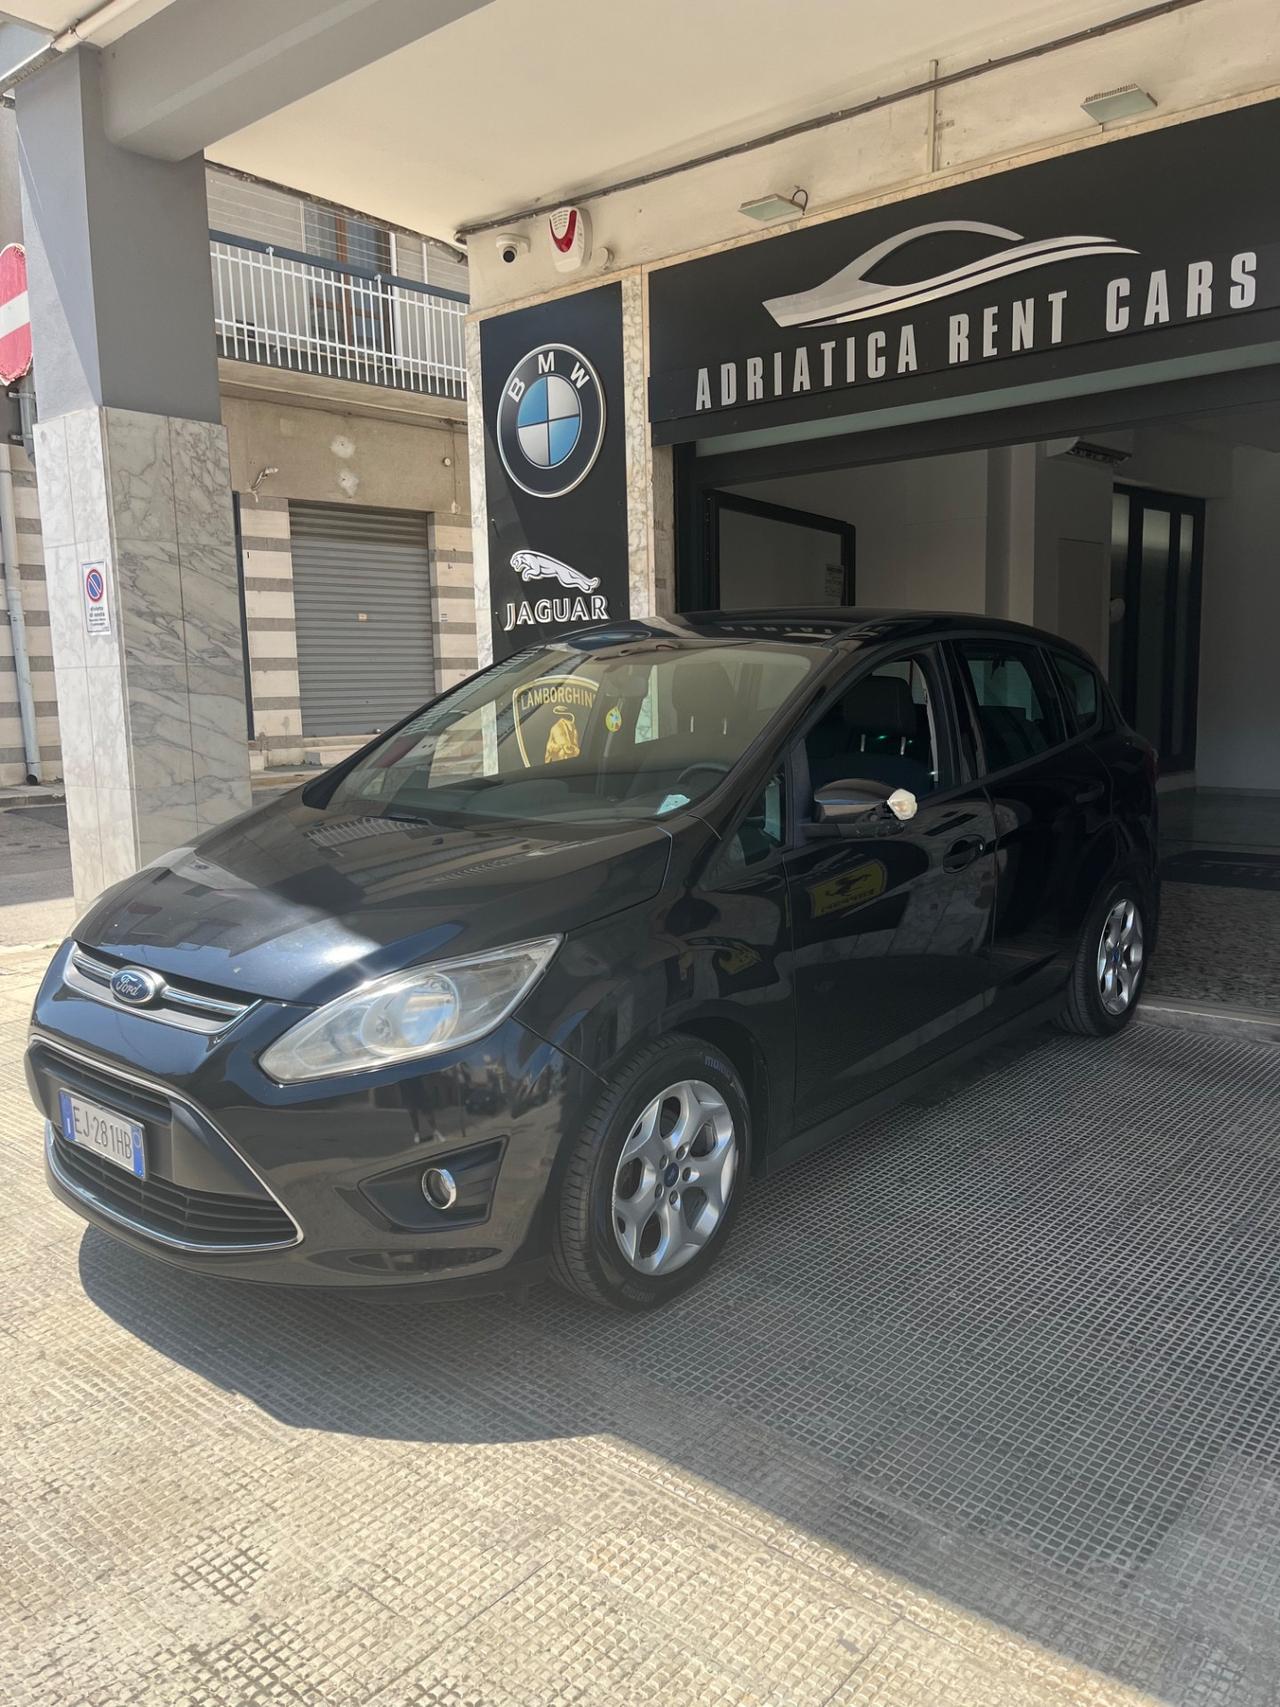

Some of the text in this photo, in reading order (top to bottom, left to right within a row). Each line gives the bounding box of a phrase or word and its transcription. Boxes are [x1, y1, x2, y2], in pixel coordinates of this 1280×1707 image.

[695, 251, 1257, 412] ADRIATICA RENT CARS
[507, 351, 590, 403] BMW
[503, 595, 610, 631] JAGUAR
[115, 974, 143, 997] Ford
